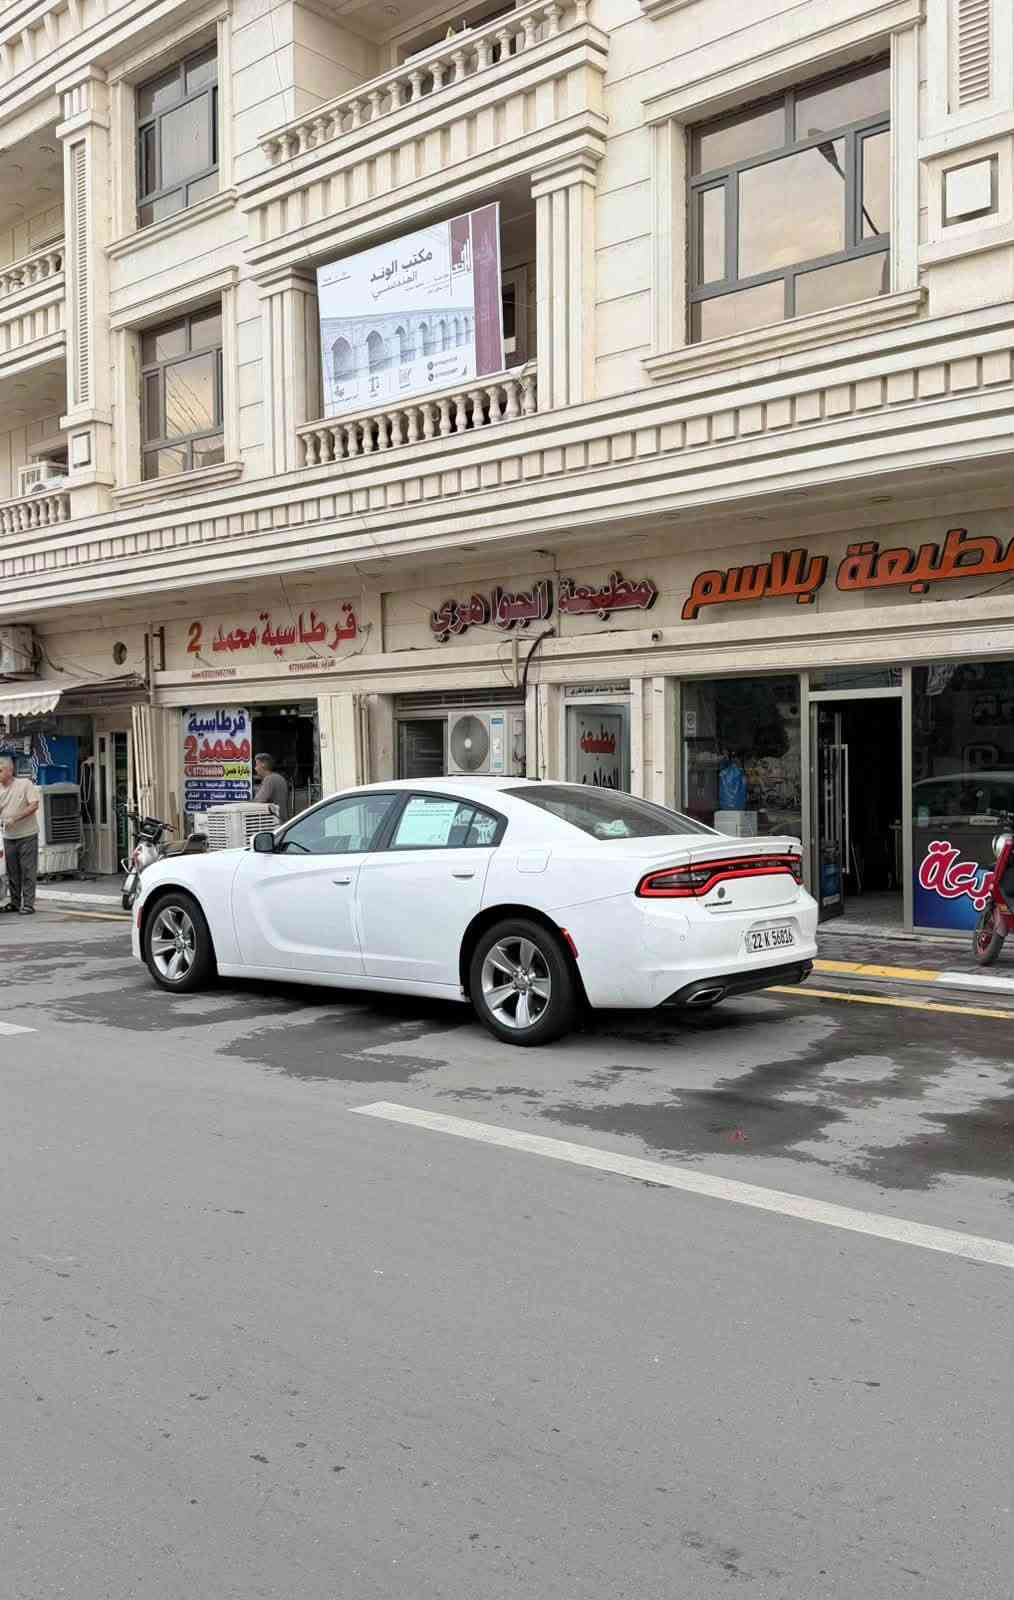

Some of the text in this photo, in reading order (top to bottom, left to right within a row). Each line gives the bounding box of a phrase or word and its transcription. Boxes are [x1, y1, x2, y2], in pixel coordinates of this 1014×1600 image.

[369, 260, 399, 283] الوند
[400, 248, 433, 271] مكتب
[681, 548, 829, 620] بلاسم
[429, 570, 659, 643] مطبعة الجواهري
[187, 602, 357, 656] قرطاسية محمد 2
[188, 709, 246, 737] قرطاسية
[184, 735, 250, 764] محمد 2
[579, 721, 617, 760] مطبعة
[752, 933, 763, 949] 22
[764, 931, 771, 947] K
